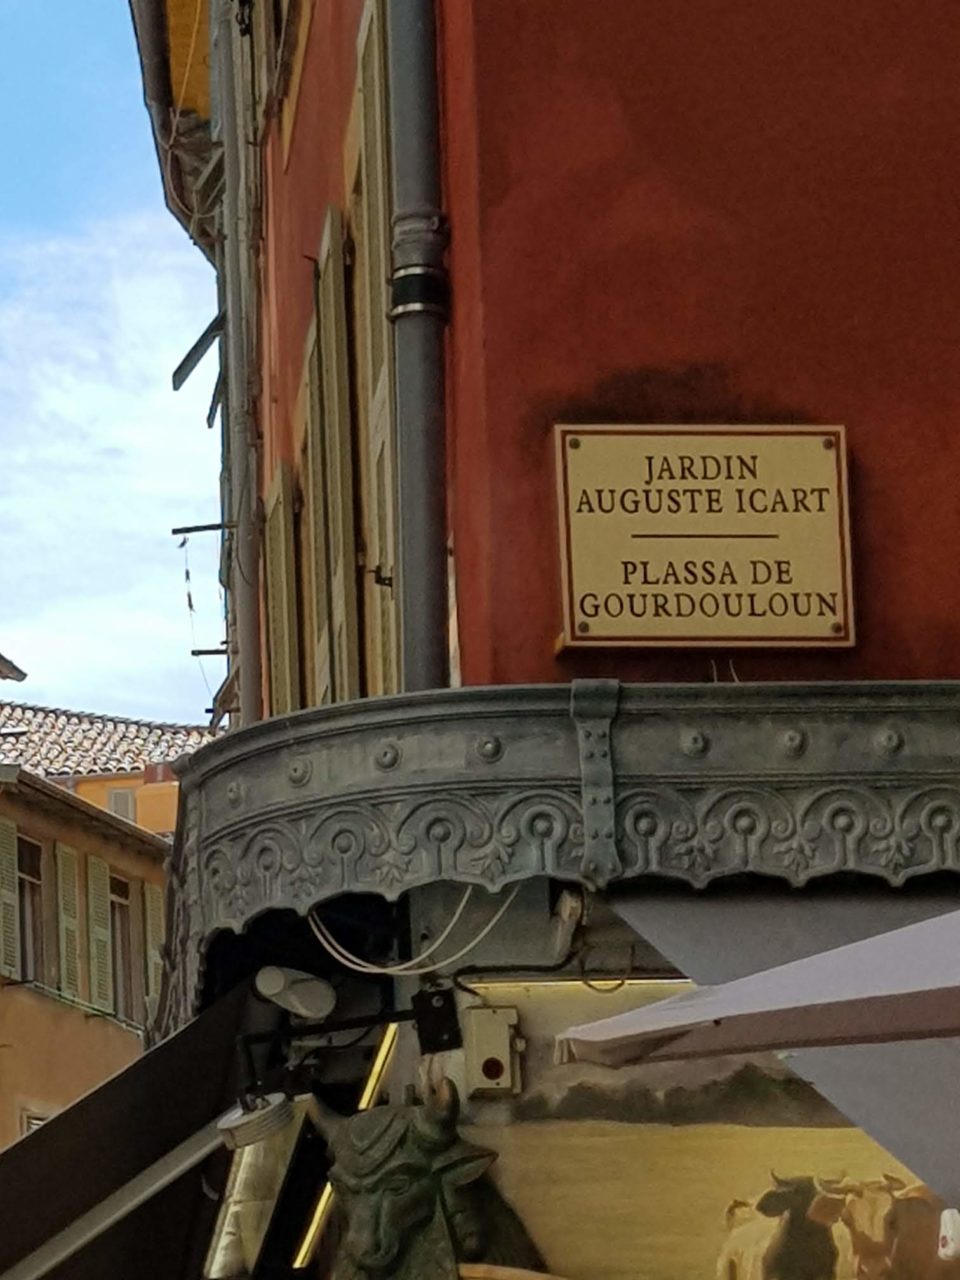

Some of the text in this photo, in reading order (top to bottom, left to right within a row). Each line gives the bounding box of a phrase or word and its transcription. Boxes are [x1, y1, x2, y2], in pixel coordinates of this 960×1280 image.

[644, 455, 759, 485] JARDIN
[576, 488, 831, 514] AUGUSTE ICART
[621, 560, 793, 585] PLASSA DE
[579, 592, 838, 618] GOURDOULOUN
